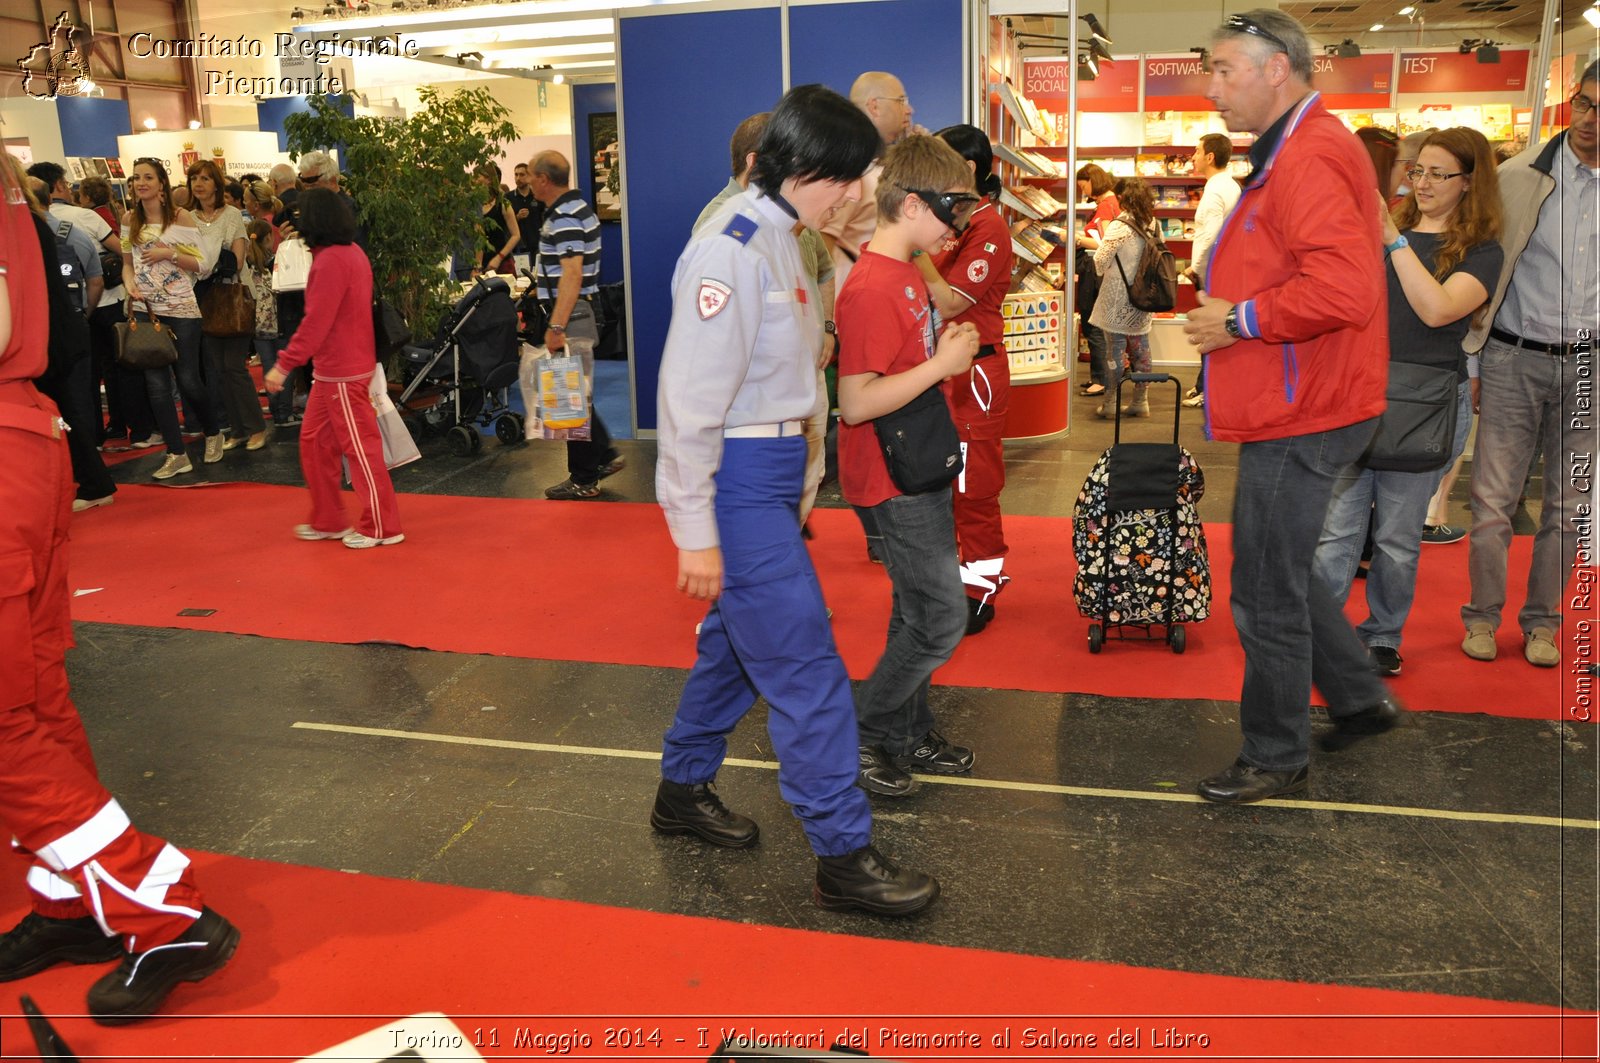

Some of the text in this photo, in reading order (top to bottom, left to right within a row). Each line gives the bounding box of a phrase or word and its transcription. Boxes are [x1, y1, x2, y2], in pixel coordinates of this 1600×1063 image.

[1403, 57, 1438, 74] TEST
[1026, 79, 1068, 93] SOCIAL
[229, 162, 246, 170] STATO
